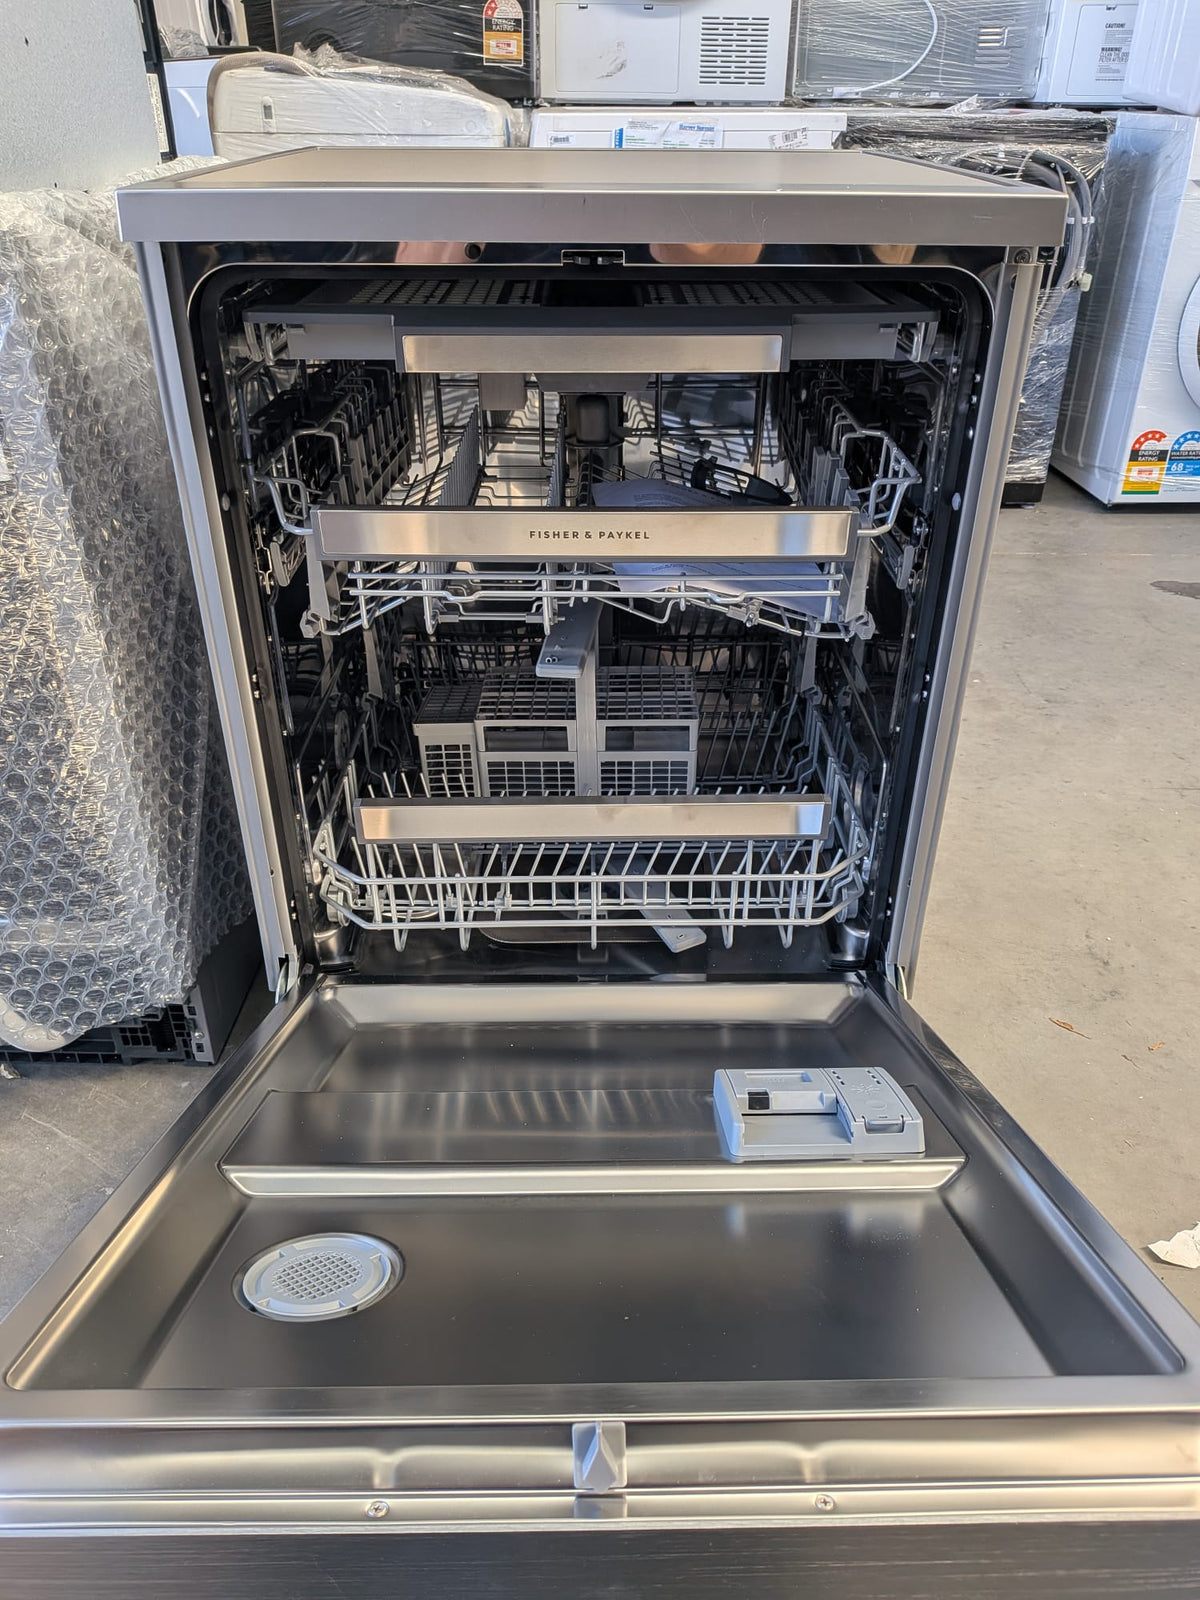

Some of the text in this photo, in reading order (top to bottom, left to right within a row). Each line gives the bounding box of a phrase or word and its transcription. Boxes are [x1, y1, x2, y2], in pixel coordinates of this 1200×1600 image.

[679, 123, 715, 132] Harvey Norman
[1171, 462, 1184, 472] 68
[529, 530, 650, 540] FISHER & PAYKEL
